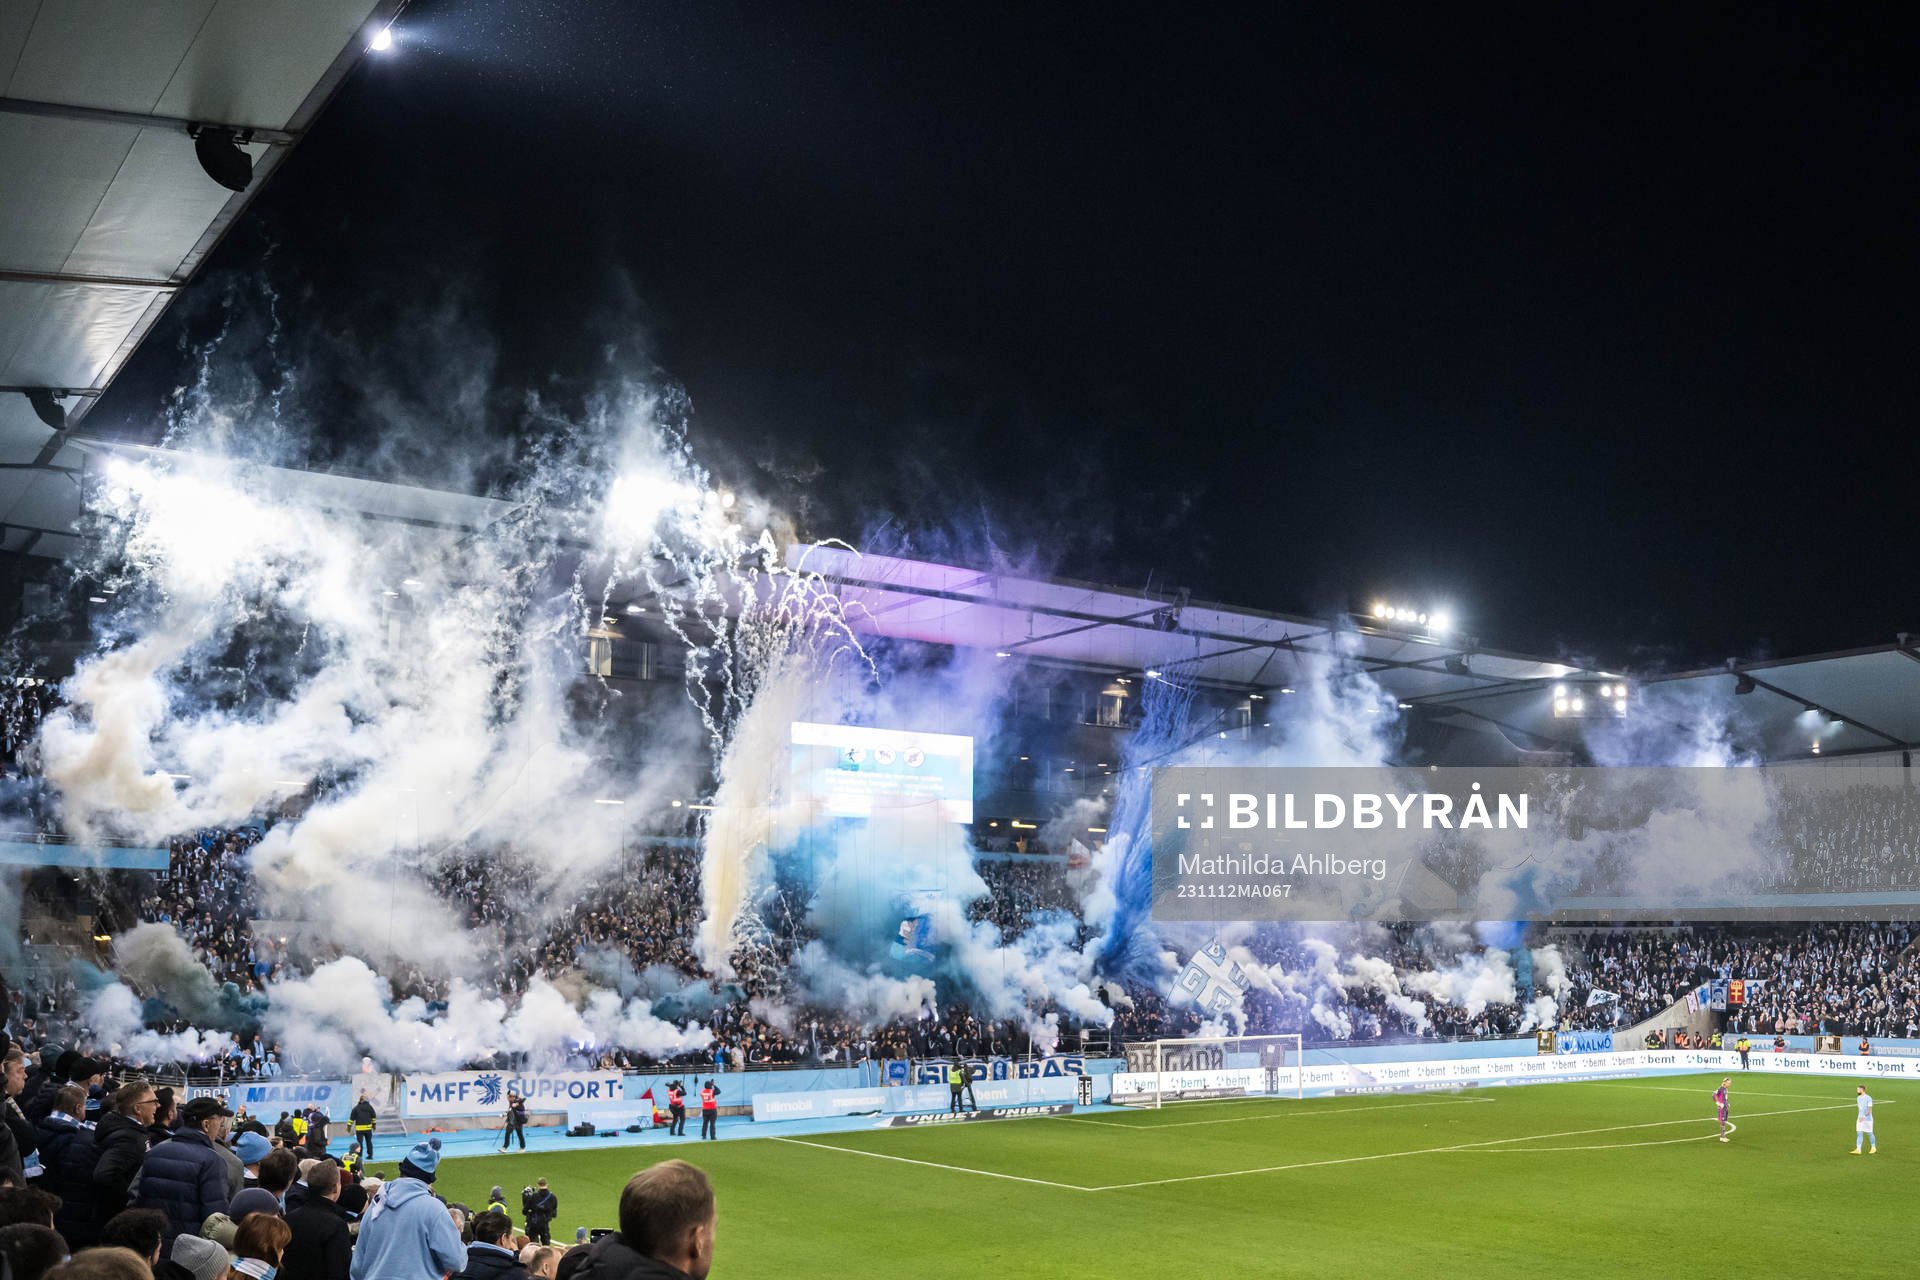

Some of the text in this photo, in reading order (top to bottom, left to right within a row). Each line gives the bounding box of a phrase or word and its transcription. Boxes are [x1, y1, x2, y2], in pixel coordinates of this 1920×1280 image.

[1588, 1058, 1606, 1068] bemt
[1618, 1056, 1634, 1066] bemt
[1648, 1054, 1675, 1064] bemt
[1697, 1055, 1722, 1064] bemt
[1748, 1057, 1765, 1066] emt
[1784, 1057, 1810, 1068] bemt
[1829, 1059, 1857, 1070] bemt
[1460, 1064, 1480, 1075] bemt
[1494, 1063, 1513, 1073] bemt
[1527, 1061, 1545, 1071] bemt
[1558, 1060, 1576, 1070] bemt
[1877, 1060, 1905, 1072] bemt
[1388, 1068, 1410, 1079] bemt
[1425, 1066, 1446, 1077] bemt
[1181, 1076, 1206, 1088] bemt
[1226, 1075, 1250, 1087] bemt
[1310, 1072, 1333, 1083] bemt
[420, 1078, 617, 1102] MFF SUPPORT
[1134, 1078, 1157, 1091] bem
[905, 1110, 981, 1122] UNIBET
[993, 1105, 1064, 1116] UNIBET
